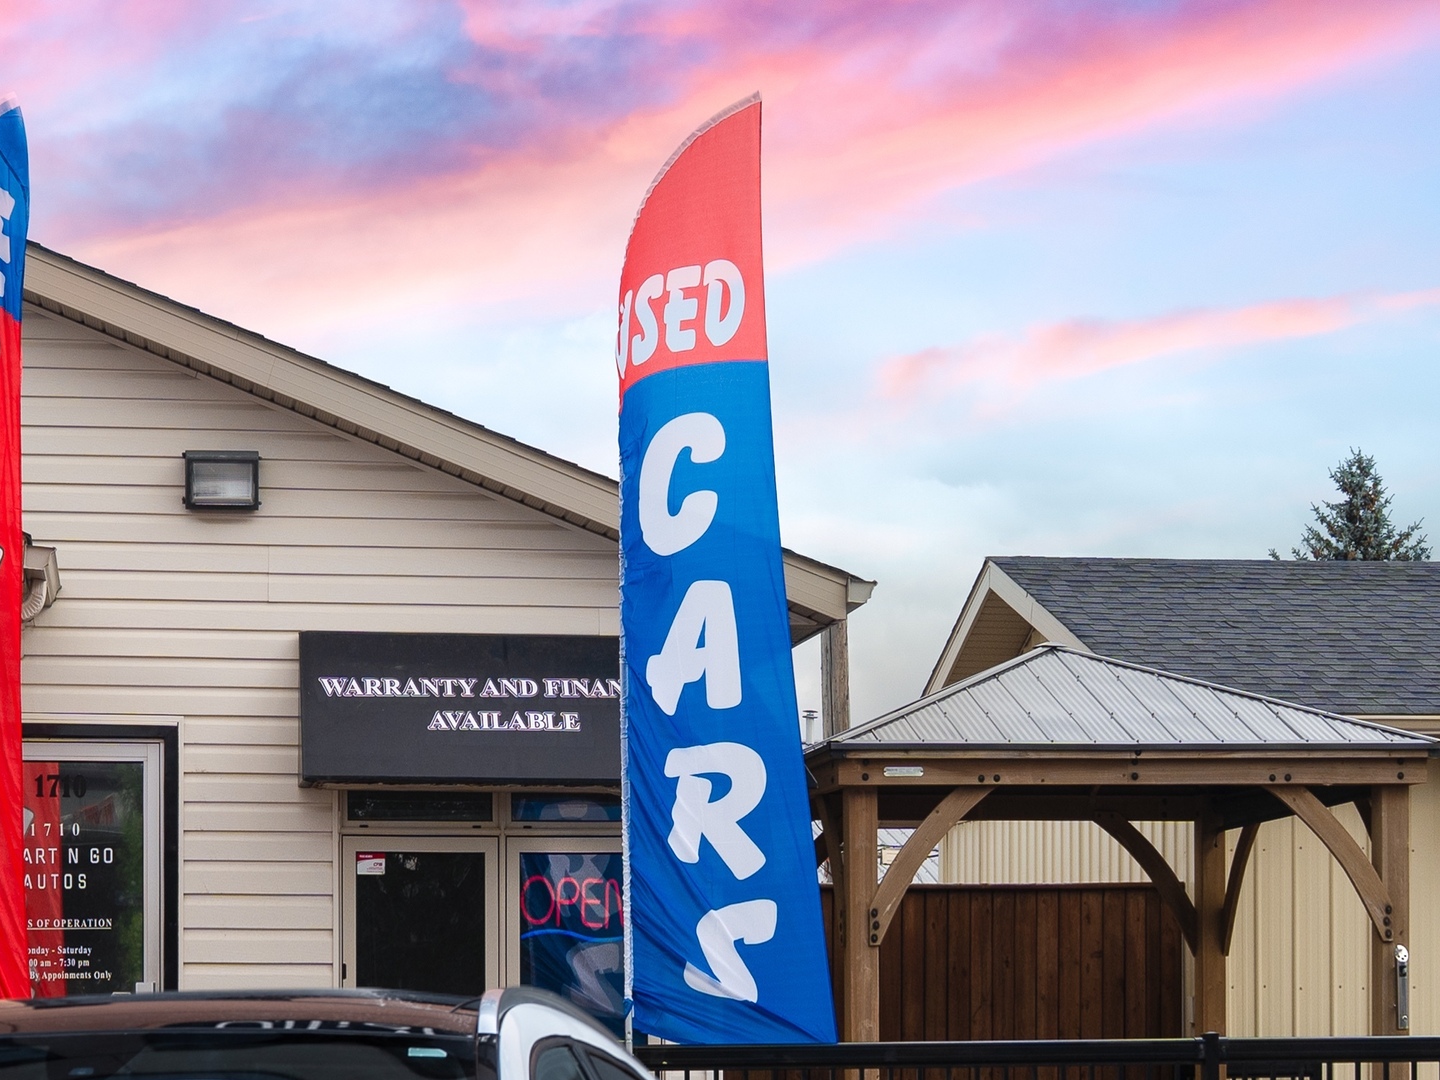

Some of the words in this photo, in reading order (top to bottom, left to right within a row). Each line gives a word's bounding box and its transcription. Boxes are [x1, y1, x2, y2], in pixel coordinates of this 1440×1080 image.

[318, 676, 478, 699] WARRANTY
[480, 677, 539, 699] AND
[542, 677, 621, 699] FINAN
[639, 411, 778, 1003] CARS
[428, 710, 582, 733] AVAILABLE
[34, 774, 87, 798] 1710
[30, 822, 81, 837] 1710
[23, 847, 58, 865] ART
[68, 847, 79, 865] N
[90, 847, 114, 865] GO
[24, 873, 87, 890] AUTOS
[520, 875, 624, 930] OPEN
[36, 918, 51, 928] OF
[53, 918, 113, 929] OPERATION
[57, 945, 93, 957] Saturday
[59, 958, 76, 967] 7:30
[77, 960, 90, 969] pm
[93, 970, 113, 981] Only
